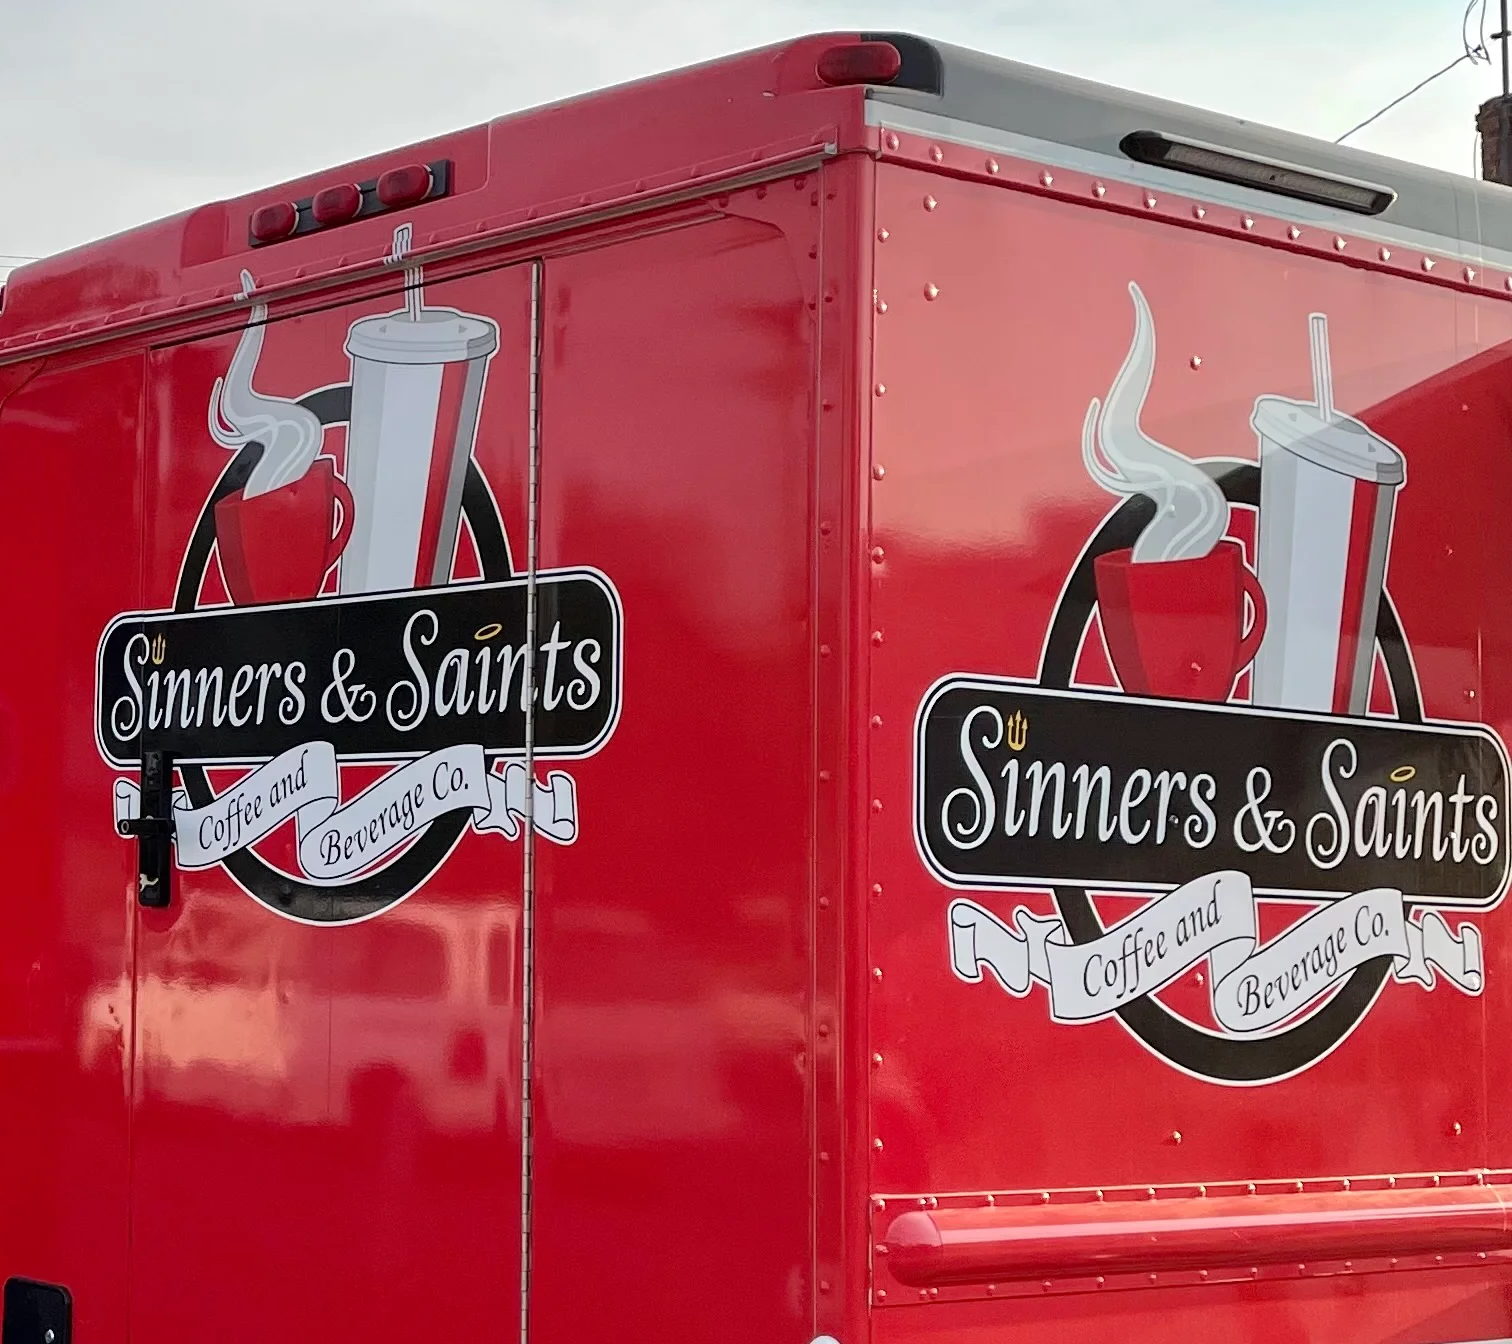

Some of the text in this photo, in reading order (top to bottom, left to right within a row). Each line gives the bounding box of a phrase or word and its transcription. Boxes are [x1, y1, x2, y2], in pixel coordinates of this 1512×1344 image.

[111, 609, 601, 741] Sinners & Saints
[198, 750, 309, 851] Coffee and
[320, 762, 470, 866] Beverage Co.
[942, 705, 1499, 870] Sinners & Saints
[1083, 880, 1222, 1000] Coffee and
[1236, 904, 1391, 1018] Beverage Co.
